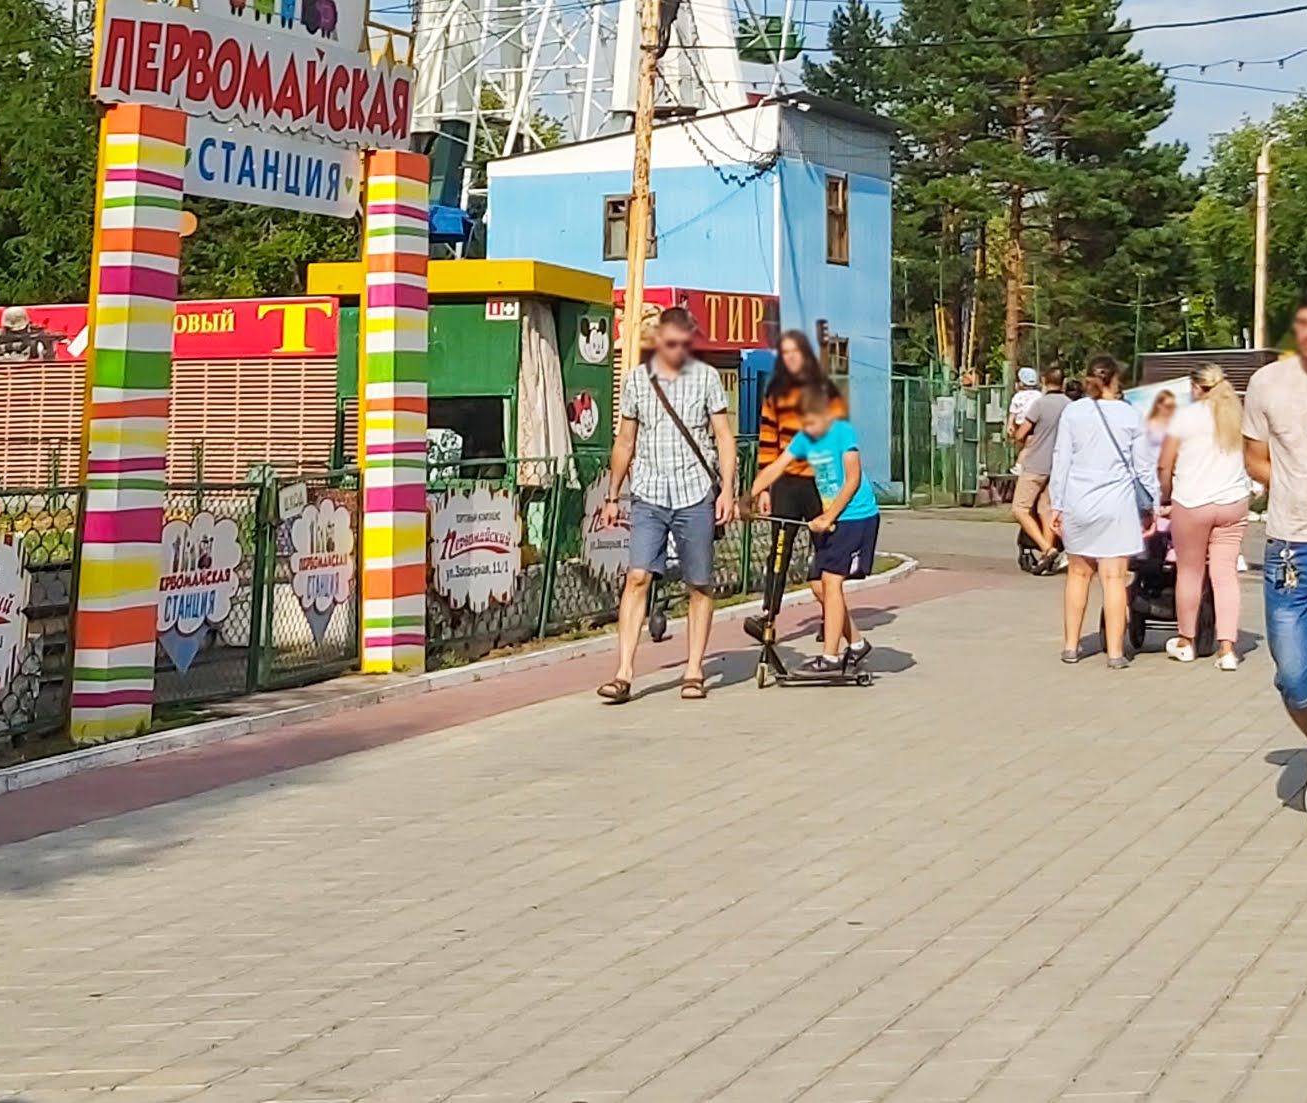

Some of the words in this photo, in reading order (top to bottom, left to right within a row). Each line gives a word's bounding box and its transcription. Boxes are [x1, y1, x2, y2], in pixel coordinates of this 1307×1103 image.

[101, 17, 412, 141] ПЕРВОМАЙСКАЯ
[197, 136, 342, 202] СТАНЦИЯ
[173, 307, 235, 334] ОВЫЙ
[704, 294, 764, 344] ТИР
[163, 589, 217, 623] СТАНЦИЯ
